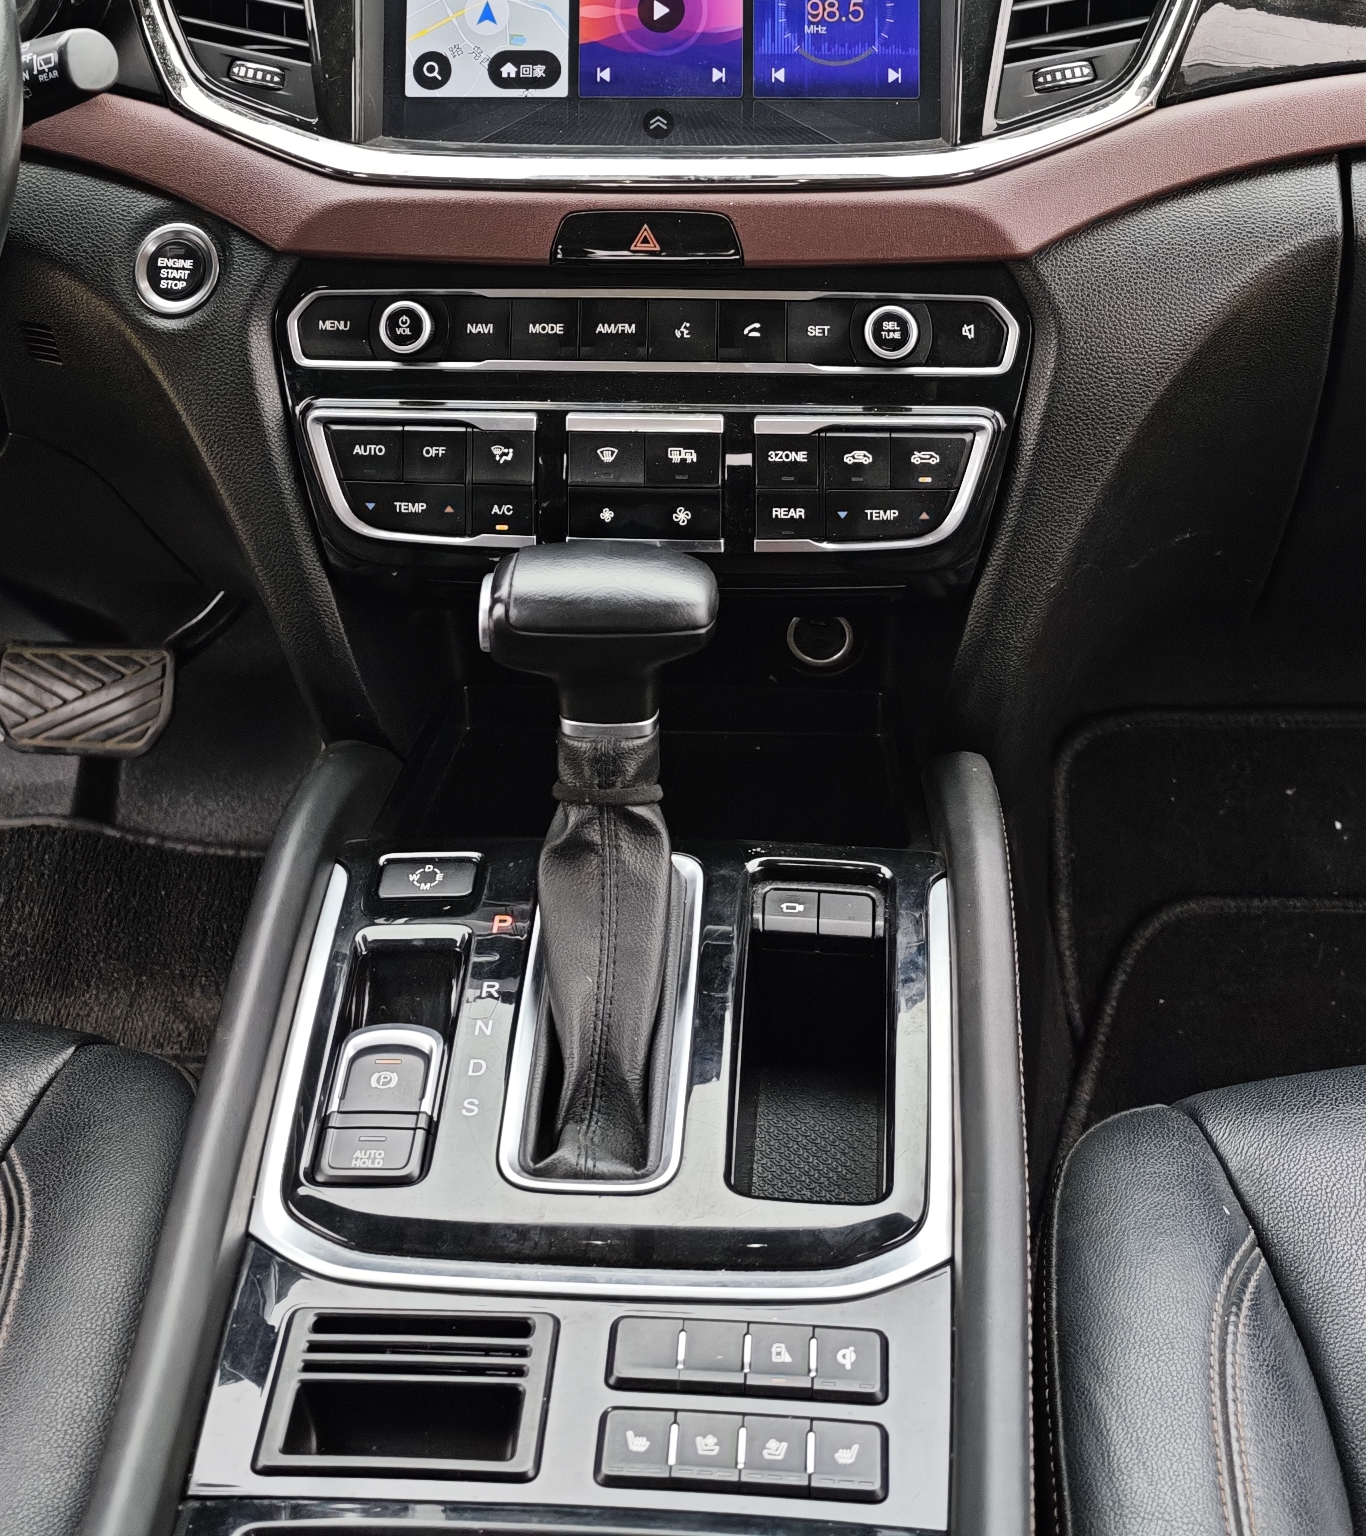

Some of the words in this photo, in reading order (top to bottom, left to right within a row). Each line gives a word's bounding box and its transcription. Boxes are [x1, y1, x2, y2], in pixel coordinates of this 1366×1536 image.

[807, 0, 864, 22] 98.5
[804, 25, 827, 34] MHz
[21, 52, 33, 64] FF
[38, 69, 60, 82] REAR
[520, 64, 546, 78] 回家
[157, 257, 194, 269] ENGINE
[160, 269, 190, 280] START
[160, 279, 187, 290] STOP
[319, 320, 350, 331] MENU
[467, 323, 493, 334] NAVI
[528, 323, 564, 335] MODE
[595, 323, 636, 334] AM/FM
[807, 325, 831, 337] SET
[882, 321, 901, 331] SEL
[396, 327, 412, 336] VOL
[881, 331, 902, 340] TUNE
[353, 445, 385, 456] AUTO
[422, 447, 446, 458] OFF
[767, 451, 808, 462] 3ZONE
[394, 502, 427, 514] TEMP
[491, 505, 513, 516] A/C
[772, 508, 805, 519] REAR
[864, 510, 899, 521] TEMP
[492, 915, 512, 933] P
[481, 982, 500, 997] R
[474, 1021, 493, 1035] N
[468, 1060, 486, 1076] D
[462, 1099, 479, 1116] S
[352, 1150, 385, 1160] AUTO
[351, 1158, 384, 1168] HOLD
